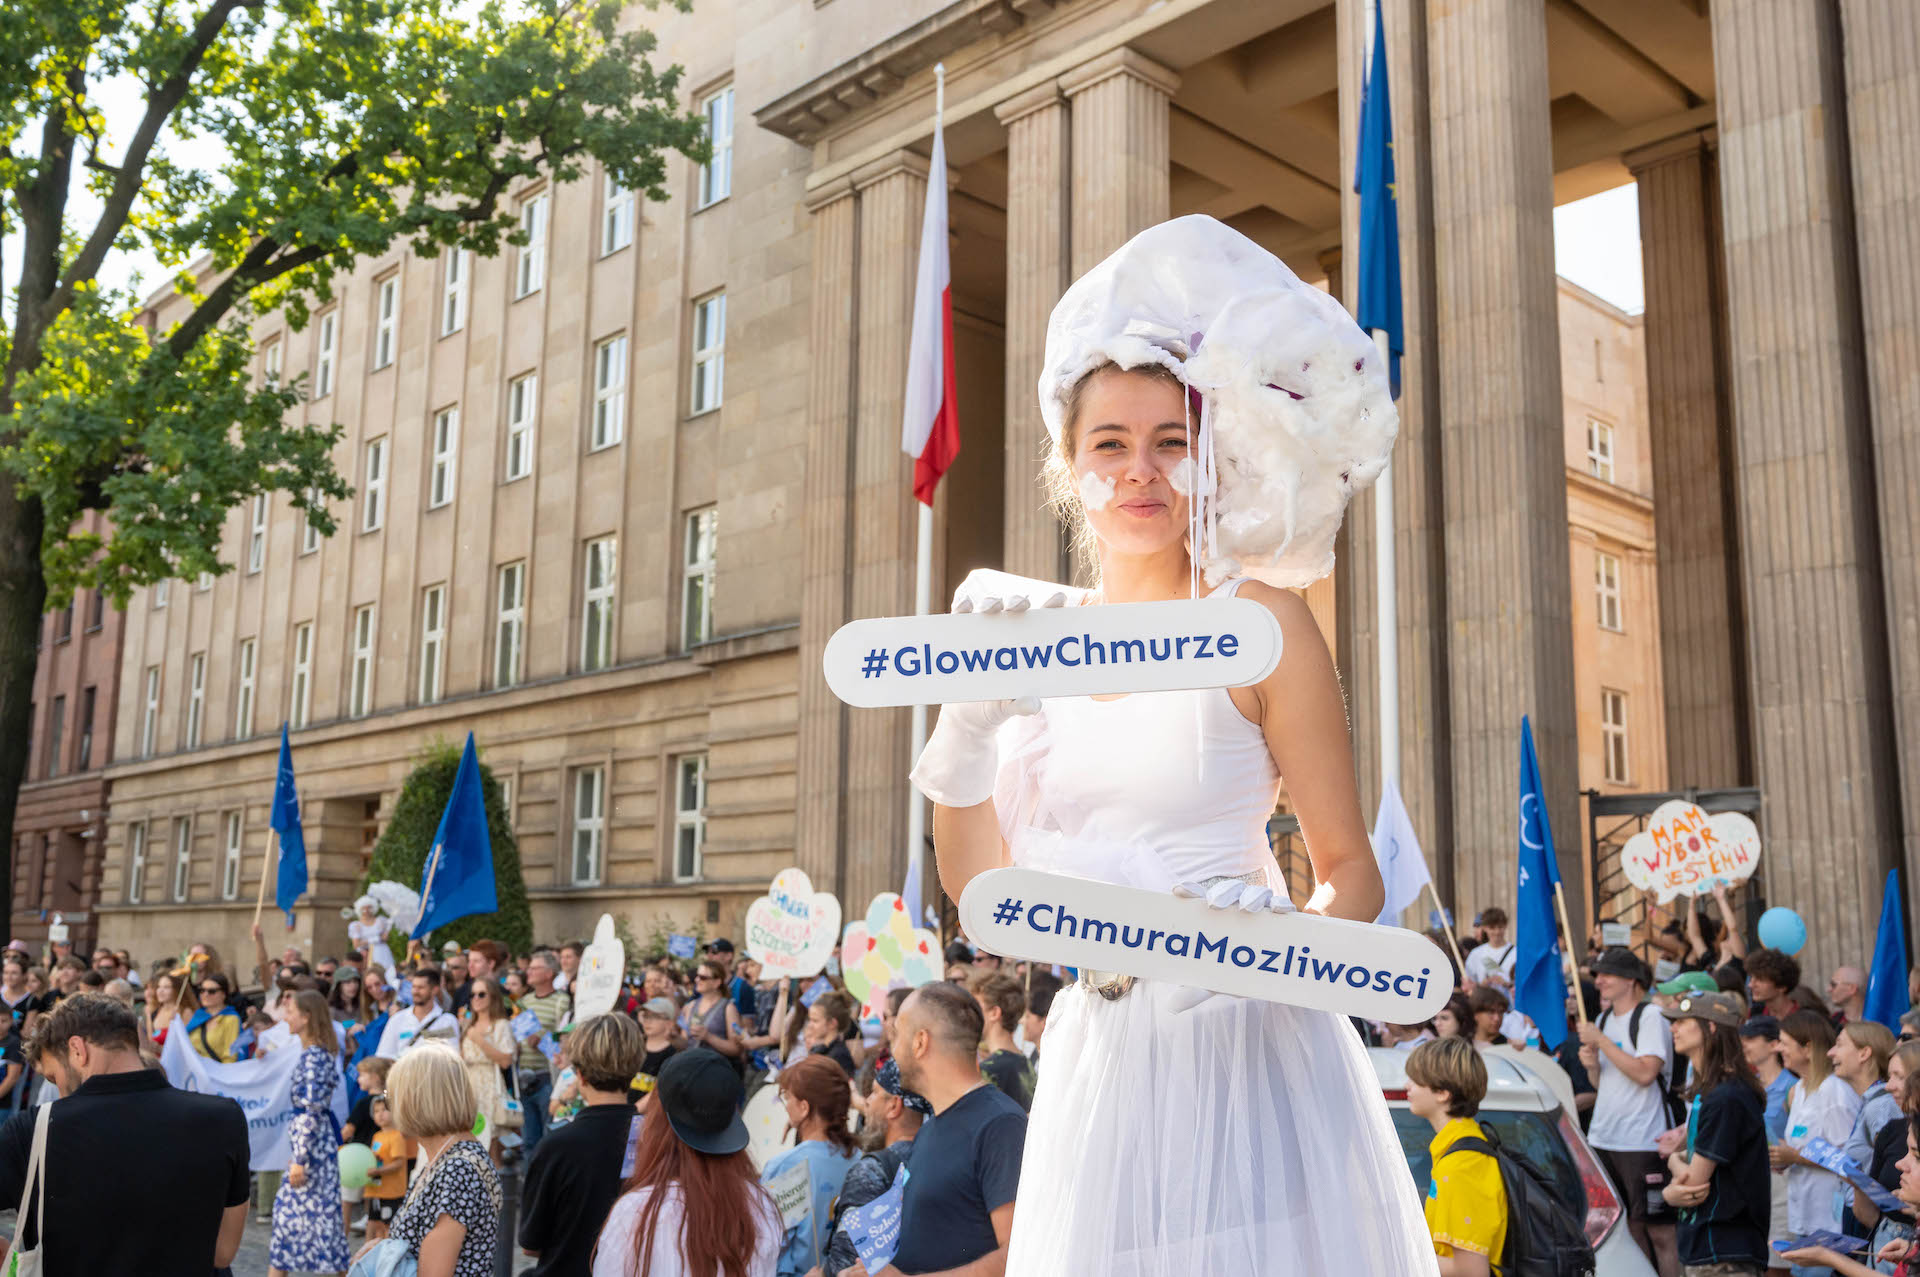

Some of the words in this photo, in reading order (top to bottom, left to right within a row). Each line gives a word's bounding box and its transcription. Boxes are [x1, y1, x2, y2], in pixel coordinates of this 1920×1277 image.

[861, 633, 1239, 679] #GlowawChmurze
[1651, 805, 1704, 849] MAM
[993, 898, 1430, 999] #ChmuraMozliwosci
[861, 1246, 875, 1259] w
